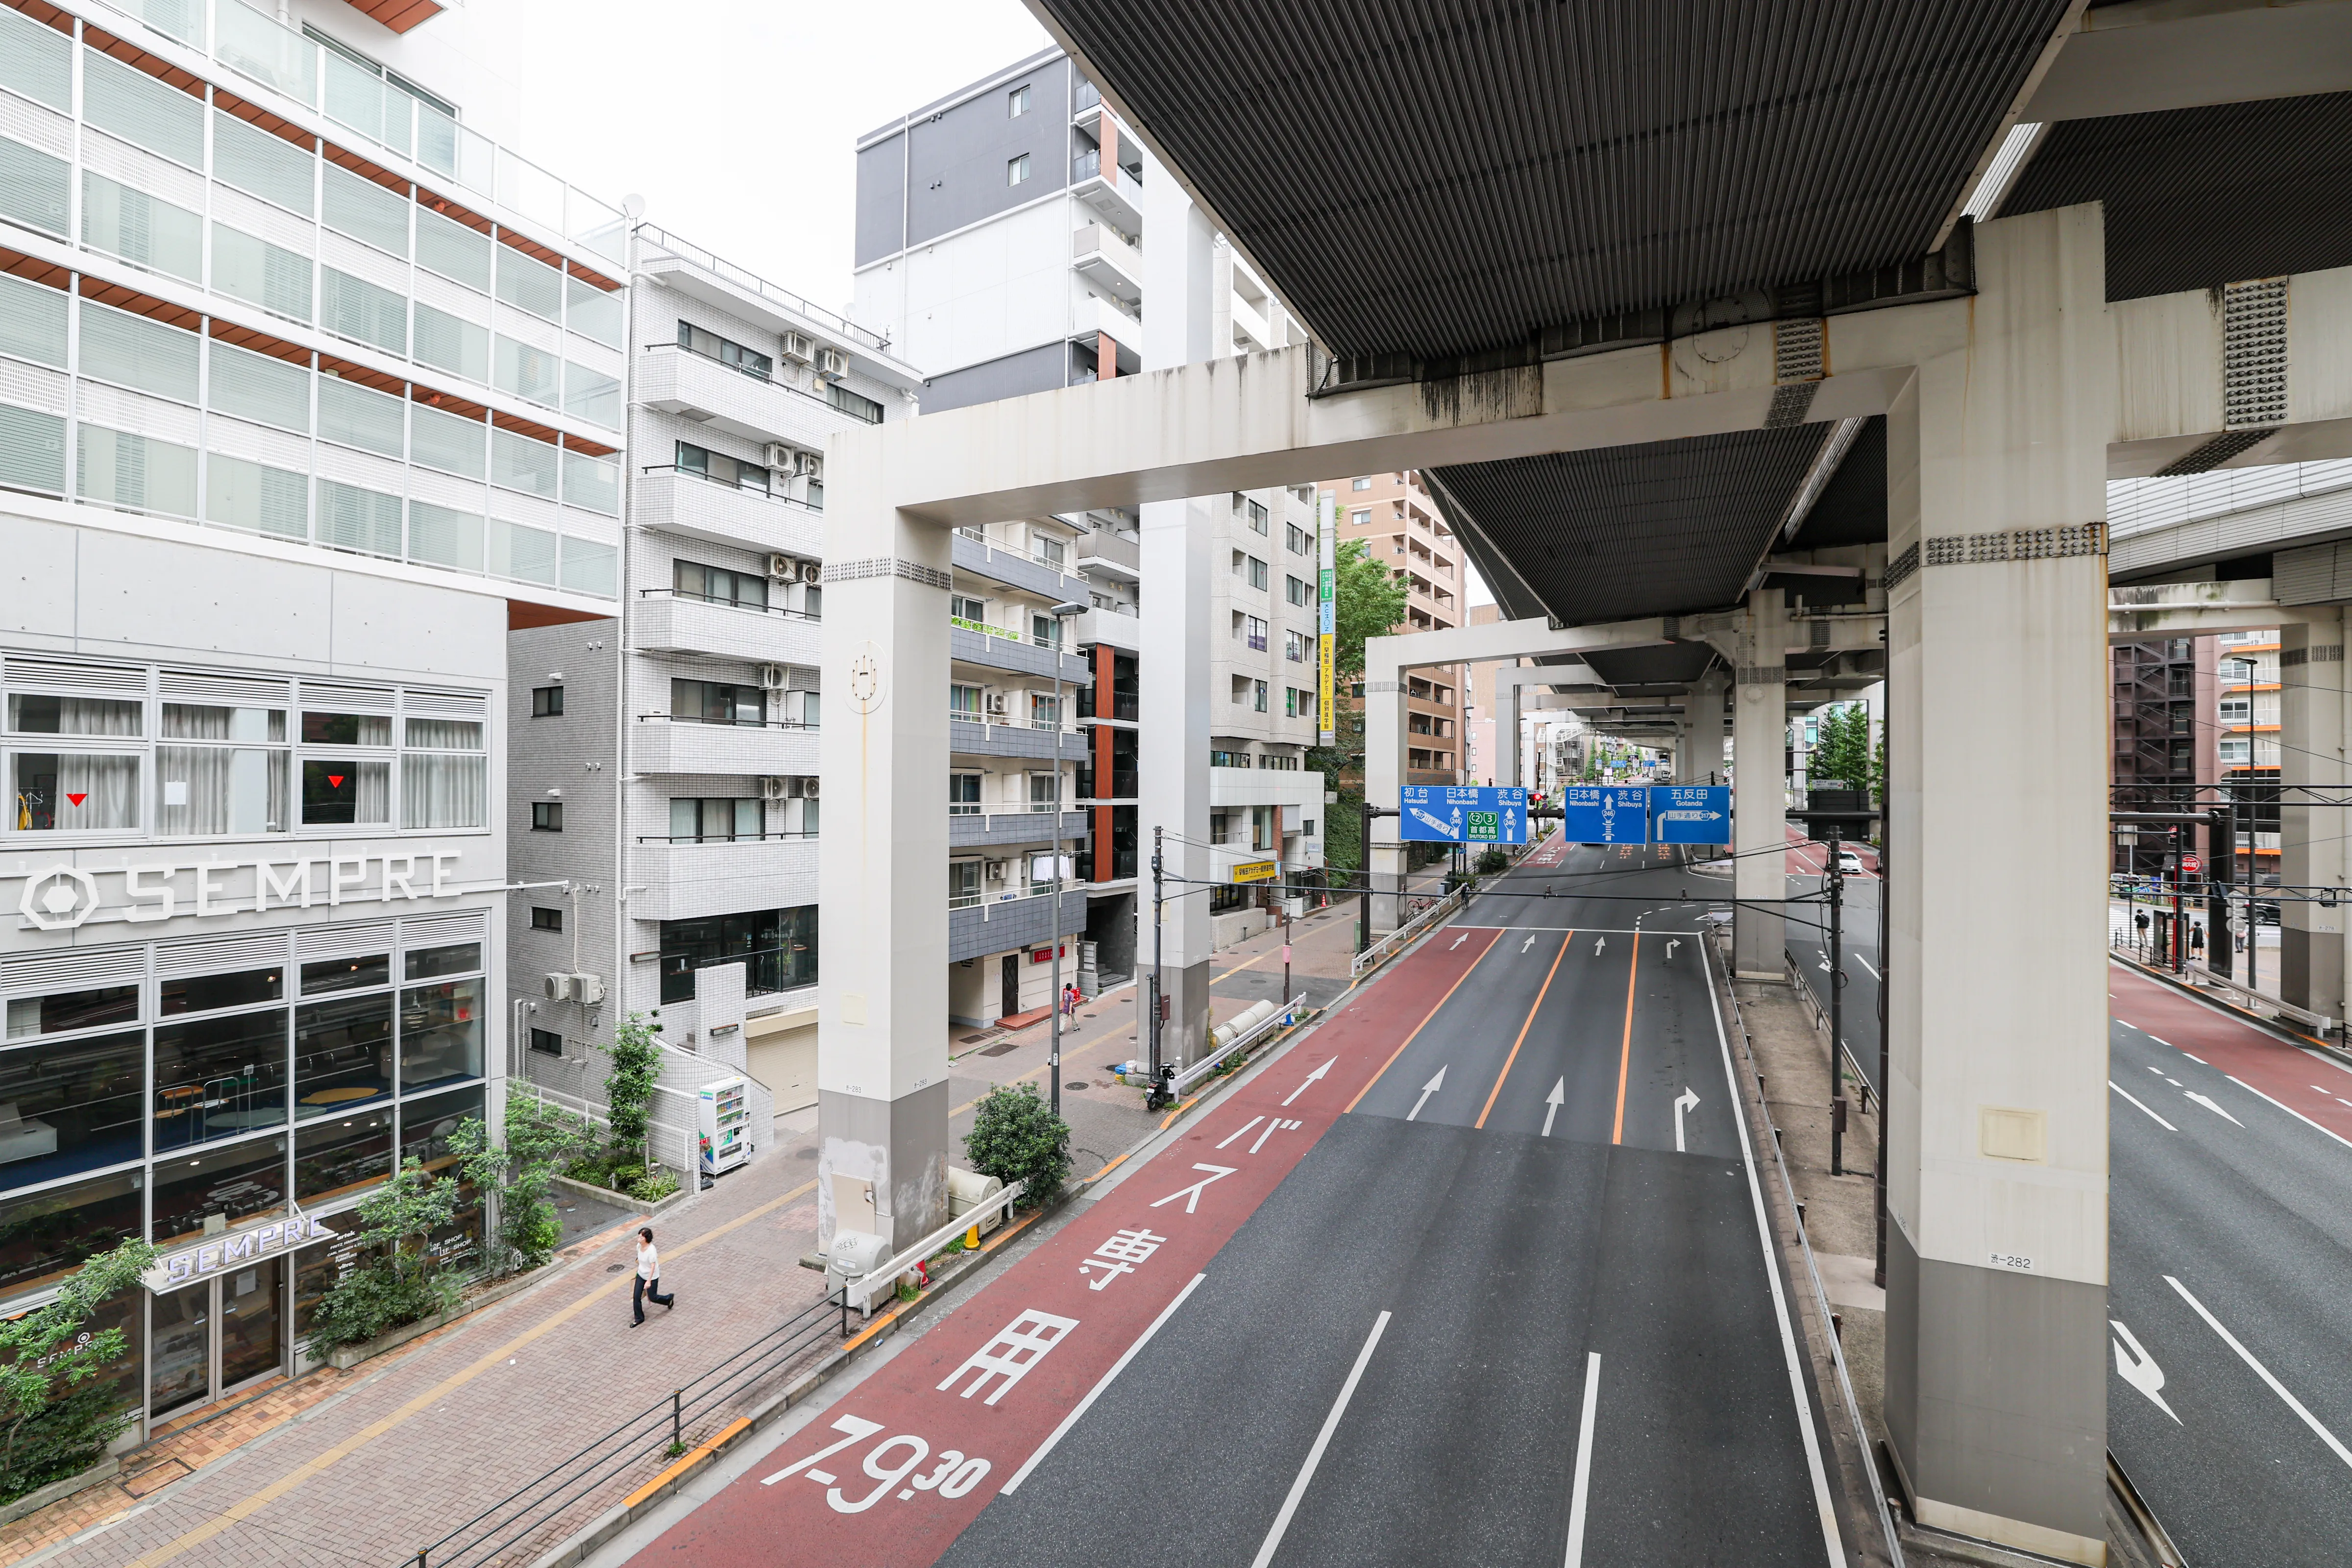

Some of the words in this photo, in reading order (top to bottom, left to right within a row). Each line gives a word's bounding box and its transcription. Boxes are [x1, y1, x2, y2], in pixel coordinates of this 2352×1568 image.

[1404, 787, 1428, 798] 初台
[1447, 788, 1478, 798] 日本橋
[1497, 789, 1523, 799] 渋谷
[1569, 789, 1600, 800] 日本橋
[1618, 790, 1642, 800] 渋谷
[1671, 789, 1708, 799] 五反田
[1424, 815, 1449, 832] 山手通り
[122, 850, 462, 922] SEMPRE
[337, 1230, 355, 1240] artek
[168, 1212, 325, 1282] SEMPRE
[335, 1252, 357, 1263] FURNITURE
